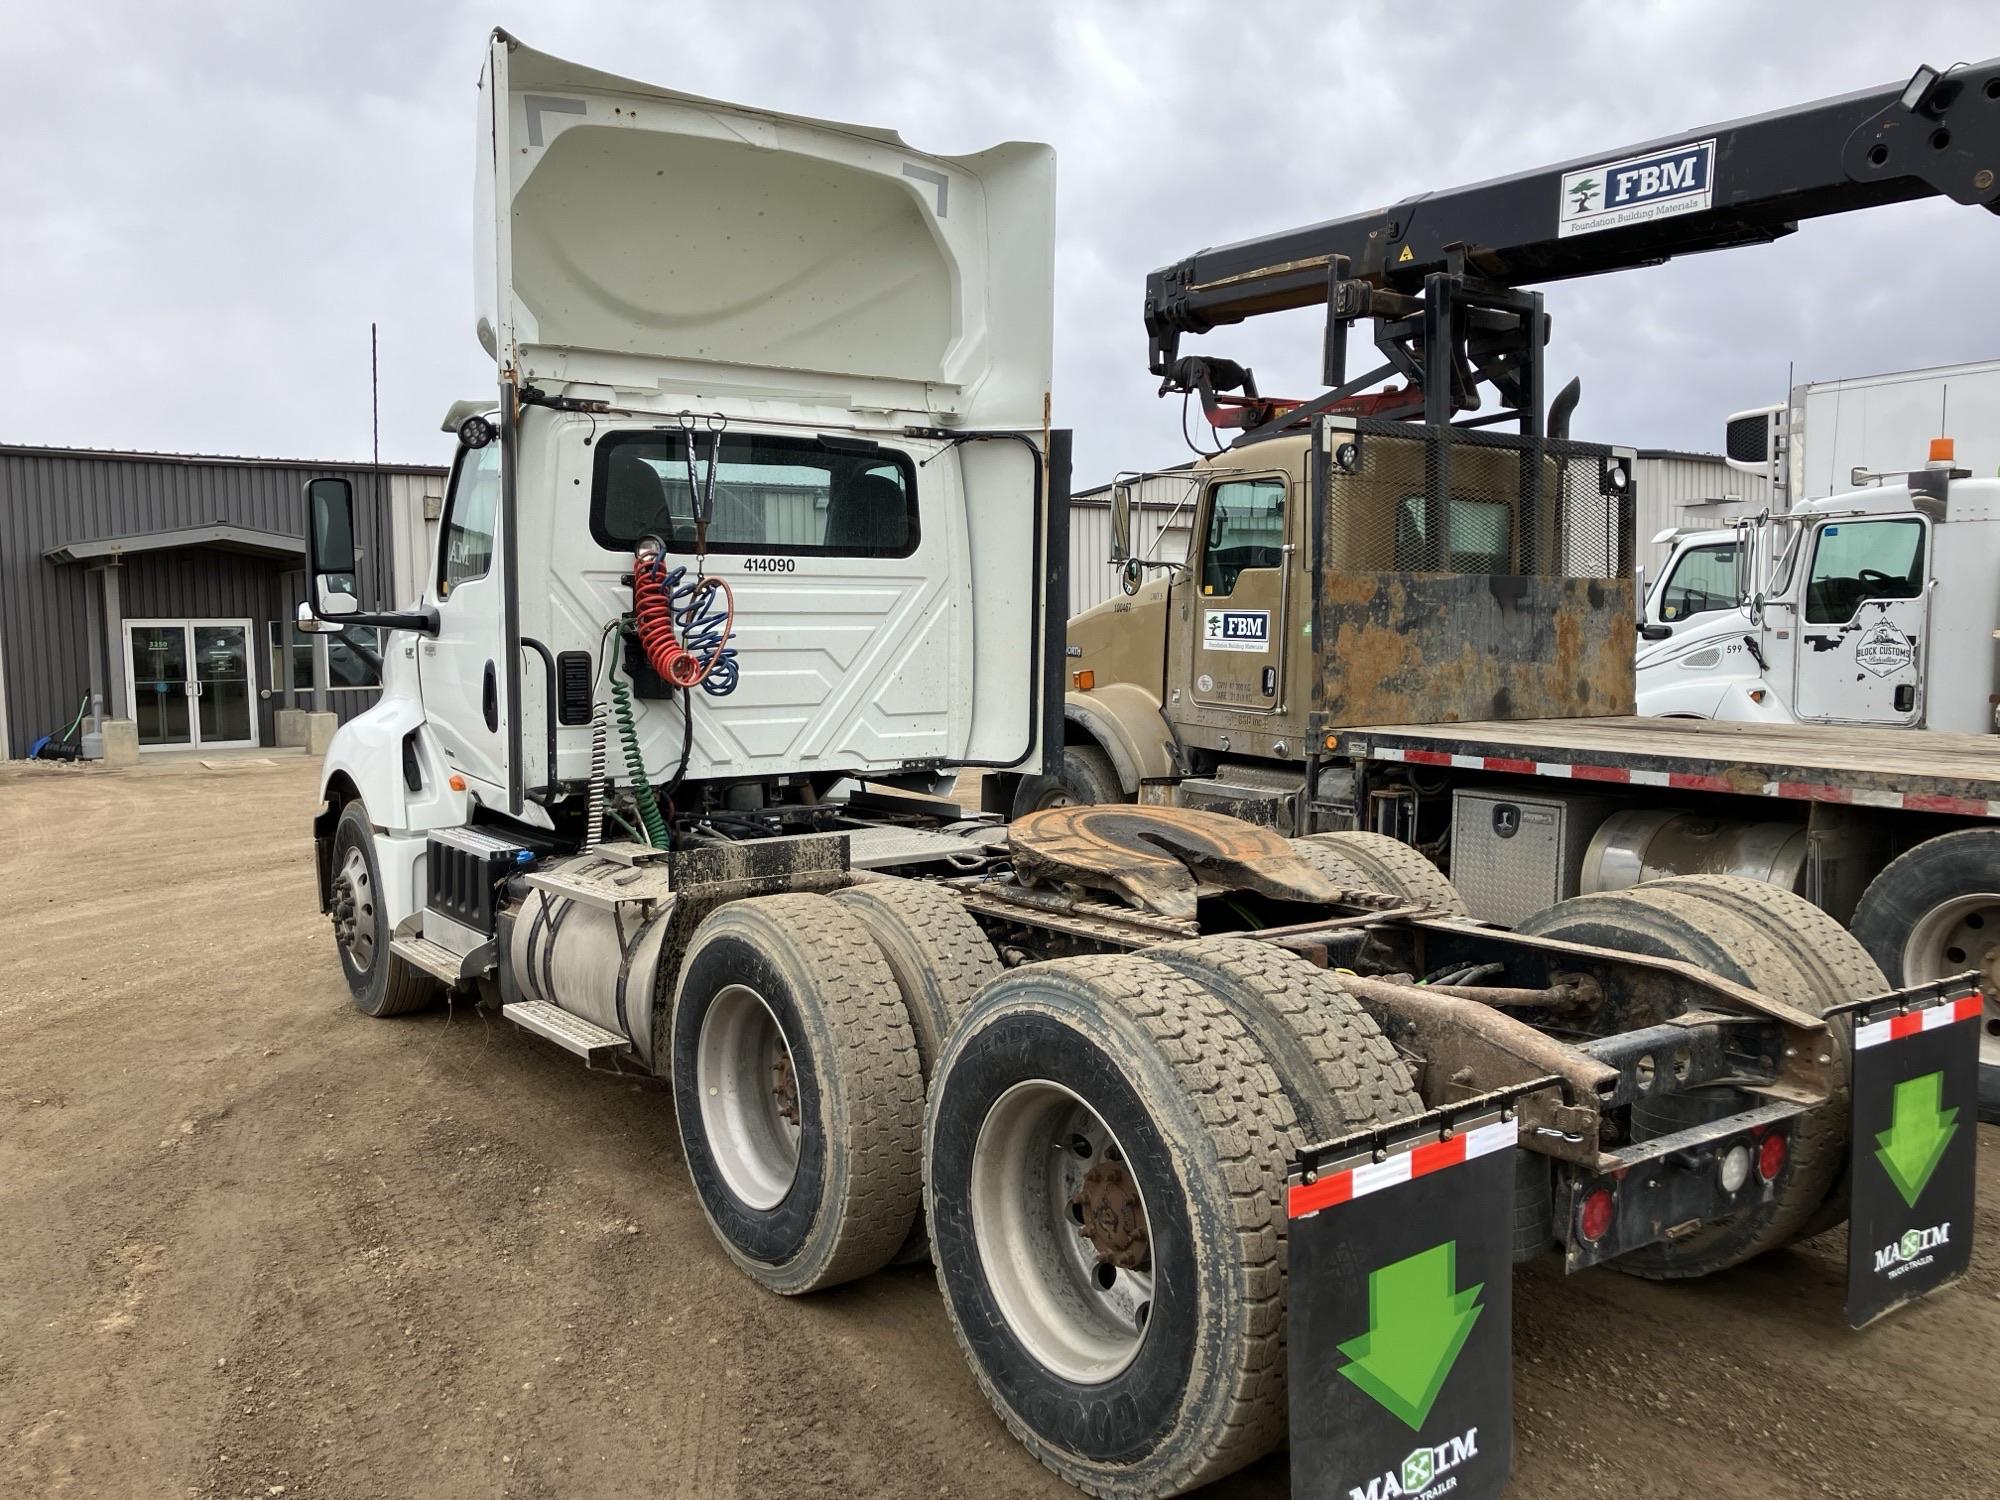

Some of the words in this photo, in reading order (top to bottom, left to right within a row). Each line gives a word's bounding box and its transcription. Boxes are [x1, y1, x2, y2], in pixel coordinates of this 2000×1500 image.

[1615, 157, 1697, 202] FBM
[1571, 217, 1616, 232] Foundation
[1618, 208, 1654, 223] Building
[1656, 199, 1698, 216] Materials
[743, 558, 795, 572] 414090
[1227, 617, 1263, 636] FBM
[1726, 644, 1743, 654] 599
[1857, 647, 1877, 657] BLOCK
[1880, 646, 1911, 657] CUSTOMS
[1873, 1222, 1951, 1273] MAXIM
[1349, 1427, 1478, 1500] MAXIM
[1420, 1476, 1458, 1500] TRAILER
